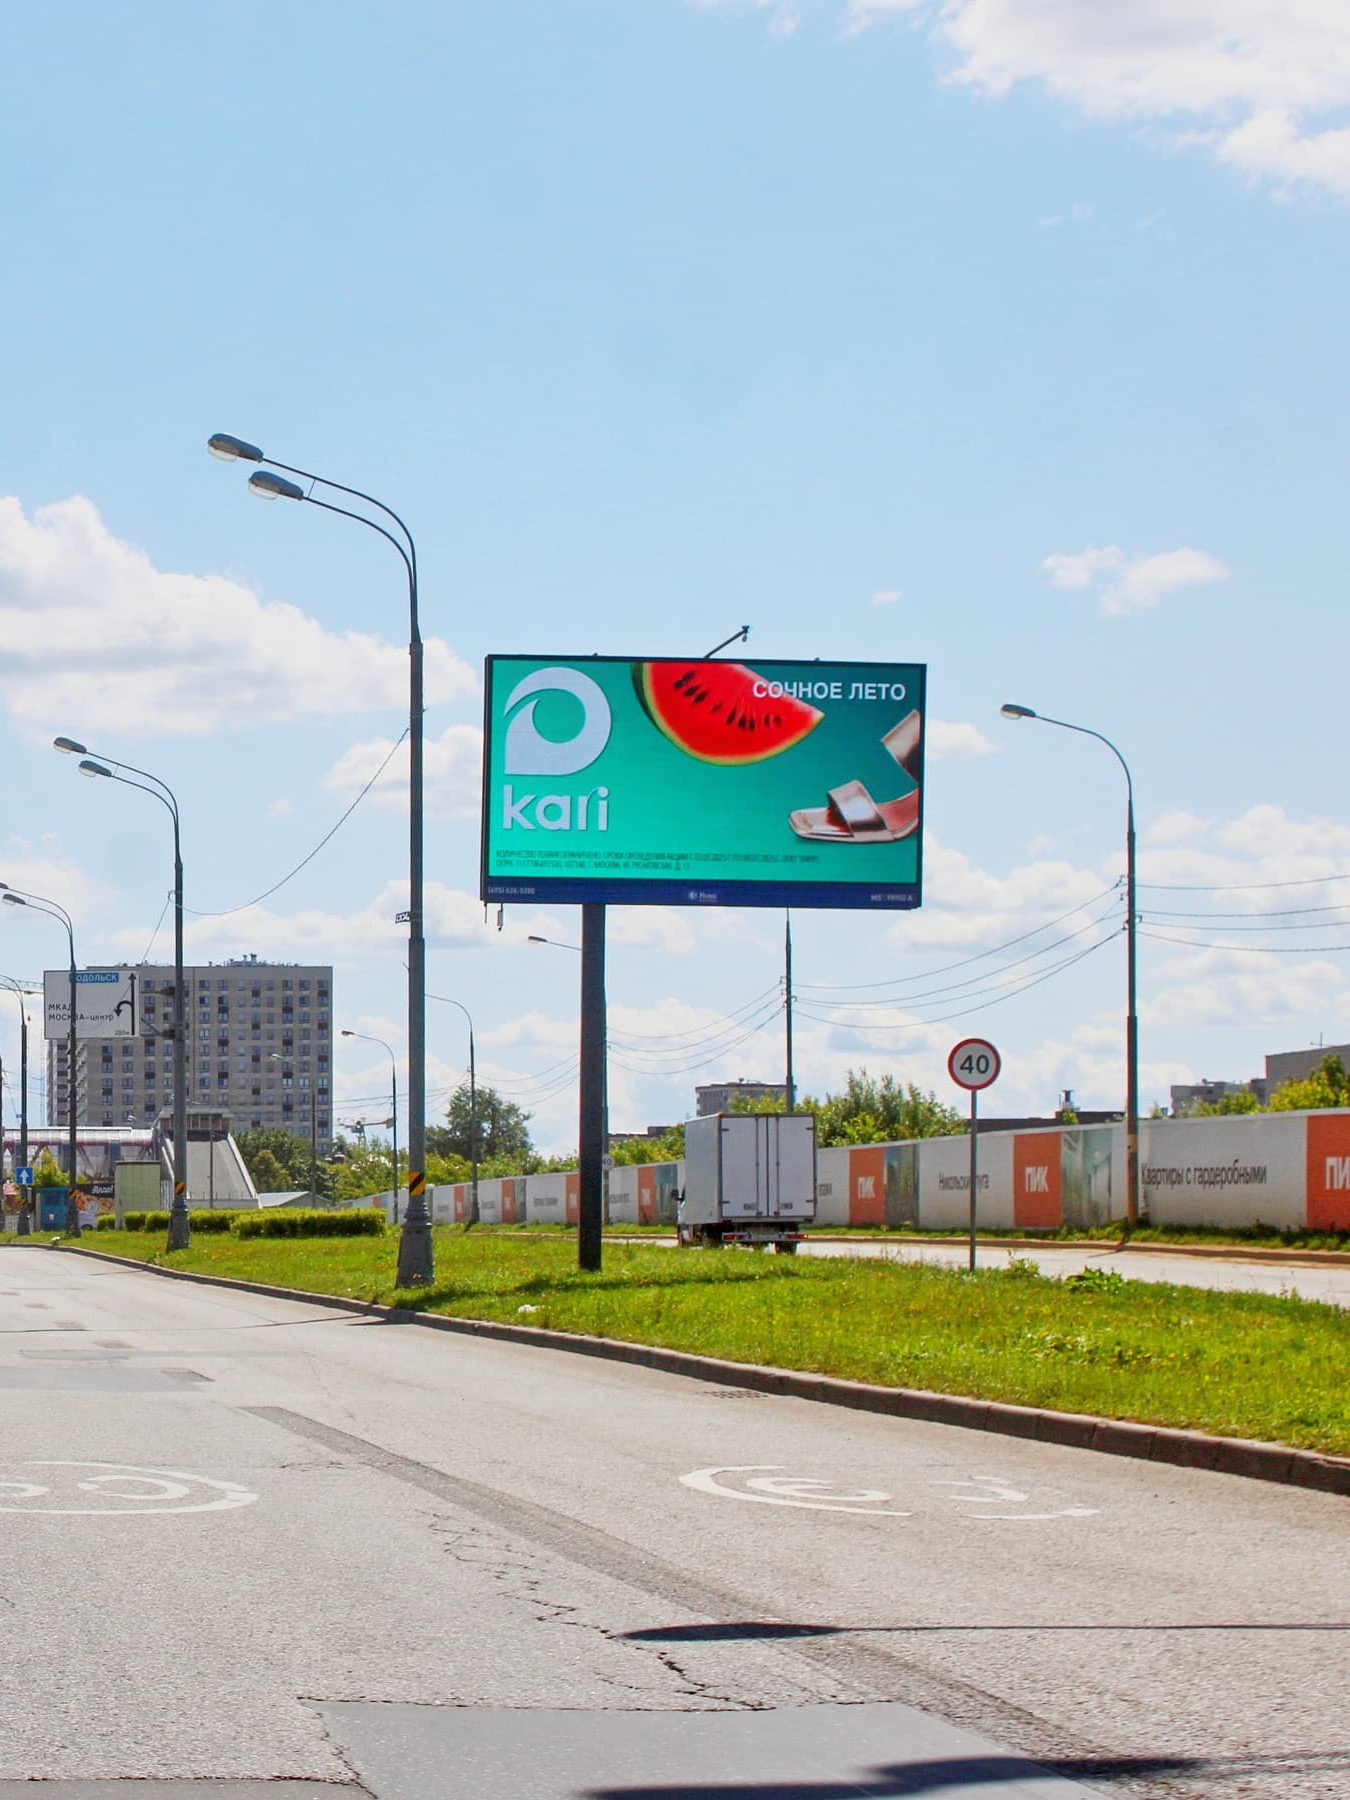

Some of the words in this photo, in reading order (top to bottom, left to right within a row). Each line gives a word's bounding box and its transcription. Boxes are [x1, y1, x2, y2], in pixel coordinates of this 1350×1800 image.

[753, 681, 842, 699] СОЧНОЕ
[849, 682, 906, 700] ЛЕТО
[503, 784, 609, 831] kari
[71, 974, 117, 983] ОДОЛЬСК
[960, 1054, 989, 1074] 40
[938, 1172, 973, 1191] Никольски
[1025, 1166, 1049, 1192] ПИК
[1141, 1163, 1184, 1190] Квартиры
[1186, 1167, 1191, 1184] с
[1194, 1159, 1267, 1190] гардеробными
[1325, 1156, 1350, 1190] ПИ
[857, 1175, 876, 1199] ПИК
